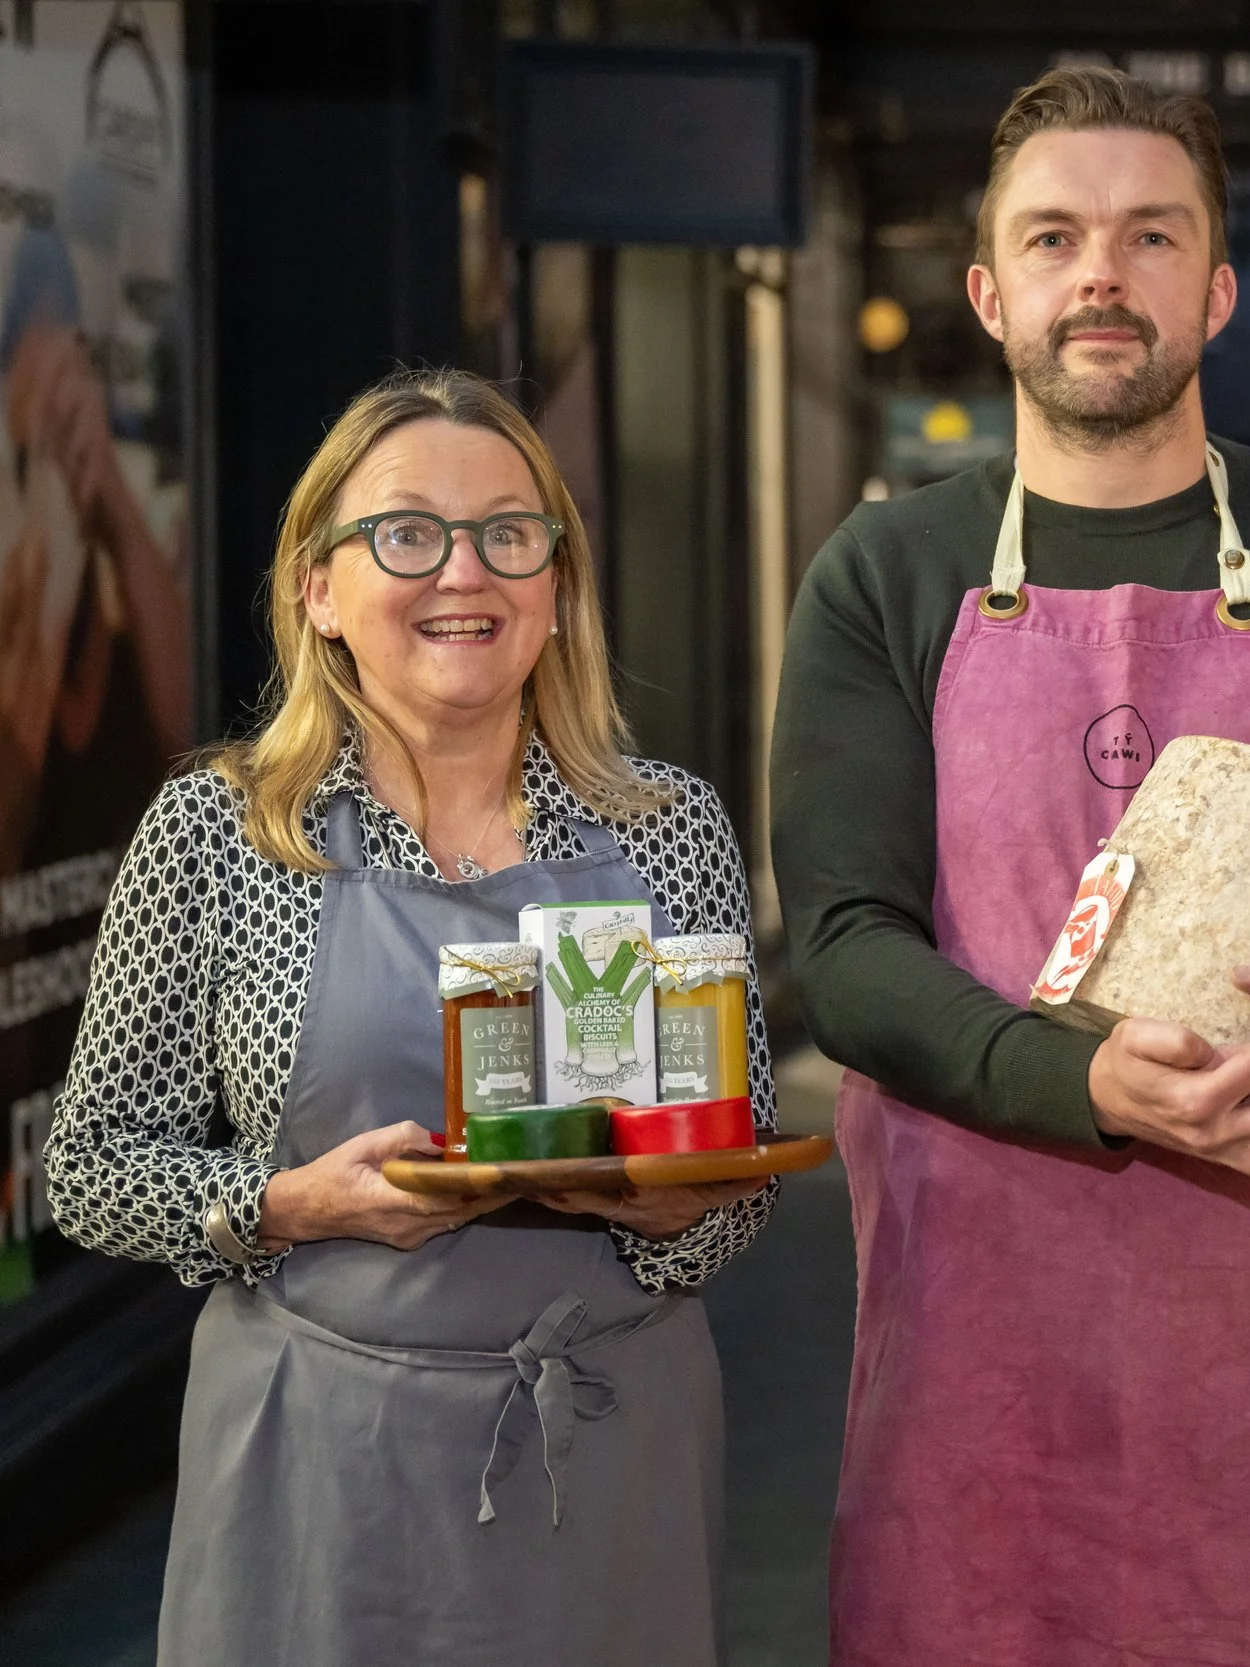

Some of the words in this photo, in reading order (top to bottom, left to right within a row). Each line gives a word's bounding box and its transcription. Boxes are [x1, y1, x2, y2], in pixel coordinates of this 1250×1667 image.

[566, 1005, 634, 1018] CRADOC'S
[473, 1021, 530, 1039] GREEN
[578, 1024, 622, 1033] COCKTAIL
[498, 1037, 514, 1052] &
[583, 1033, 618, 1041] BISCUITS
[670, 1037, 684, 1052] &
[477, 1054, 530, 1071] JENKS
